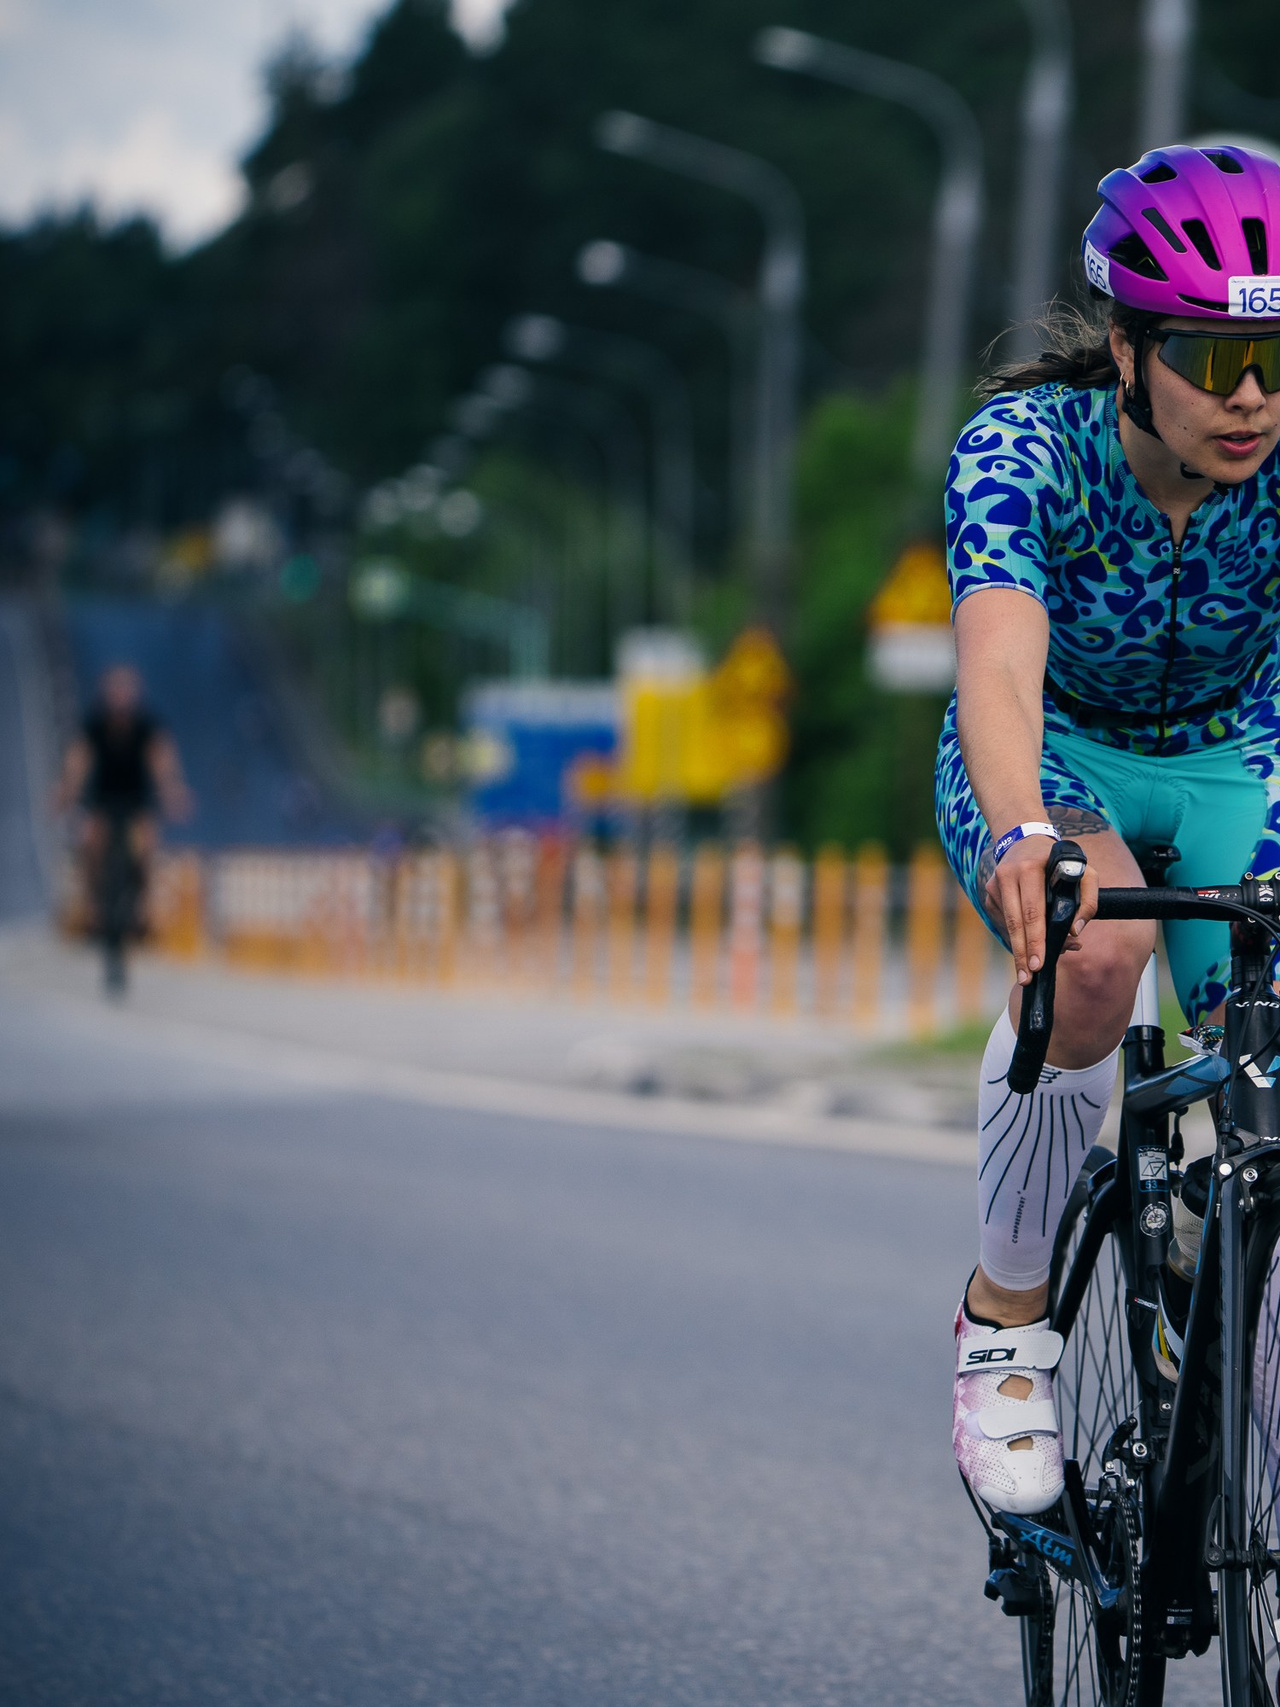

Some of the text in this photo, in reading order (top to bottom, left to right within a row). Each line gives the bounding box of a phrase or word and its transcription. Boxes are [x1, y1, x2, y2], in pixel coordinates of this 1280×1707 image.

[1087, 254, 1107, 290] 165
[1145, 1180, 1158, 1190] 53
[966, 1347, 1017, 1366] SIDI
